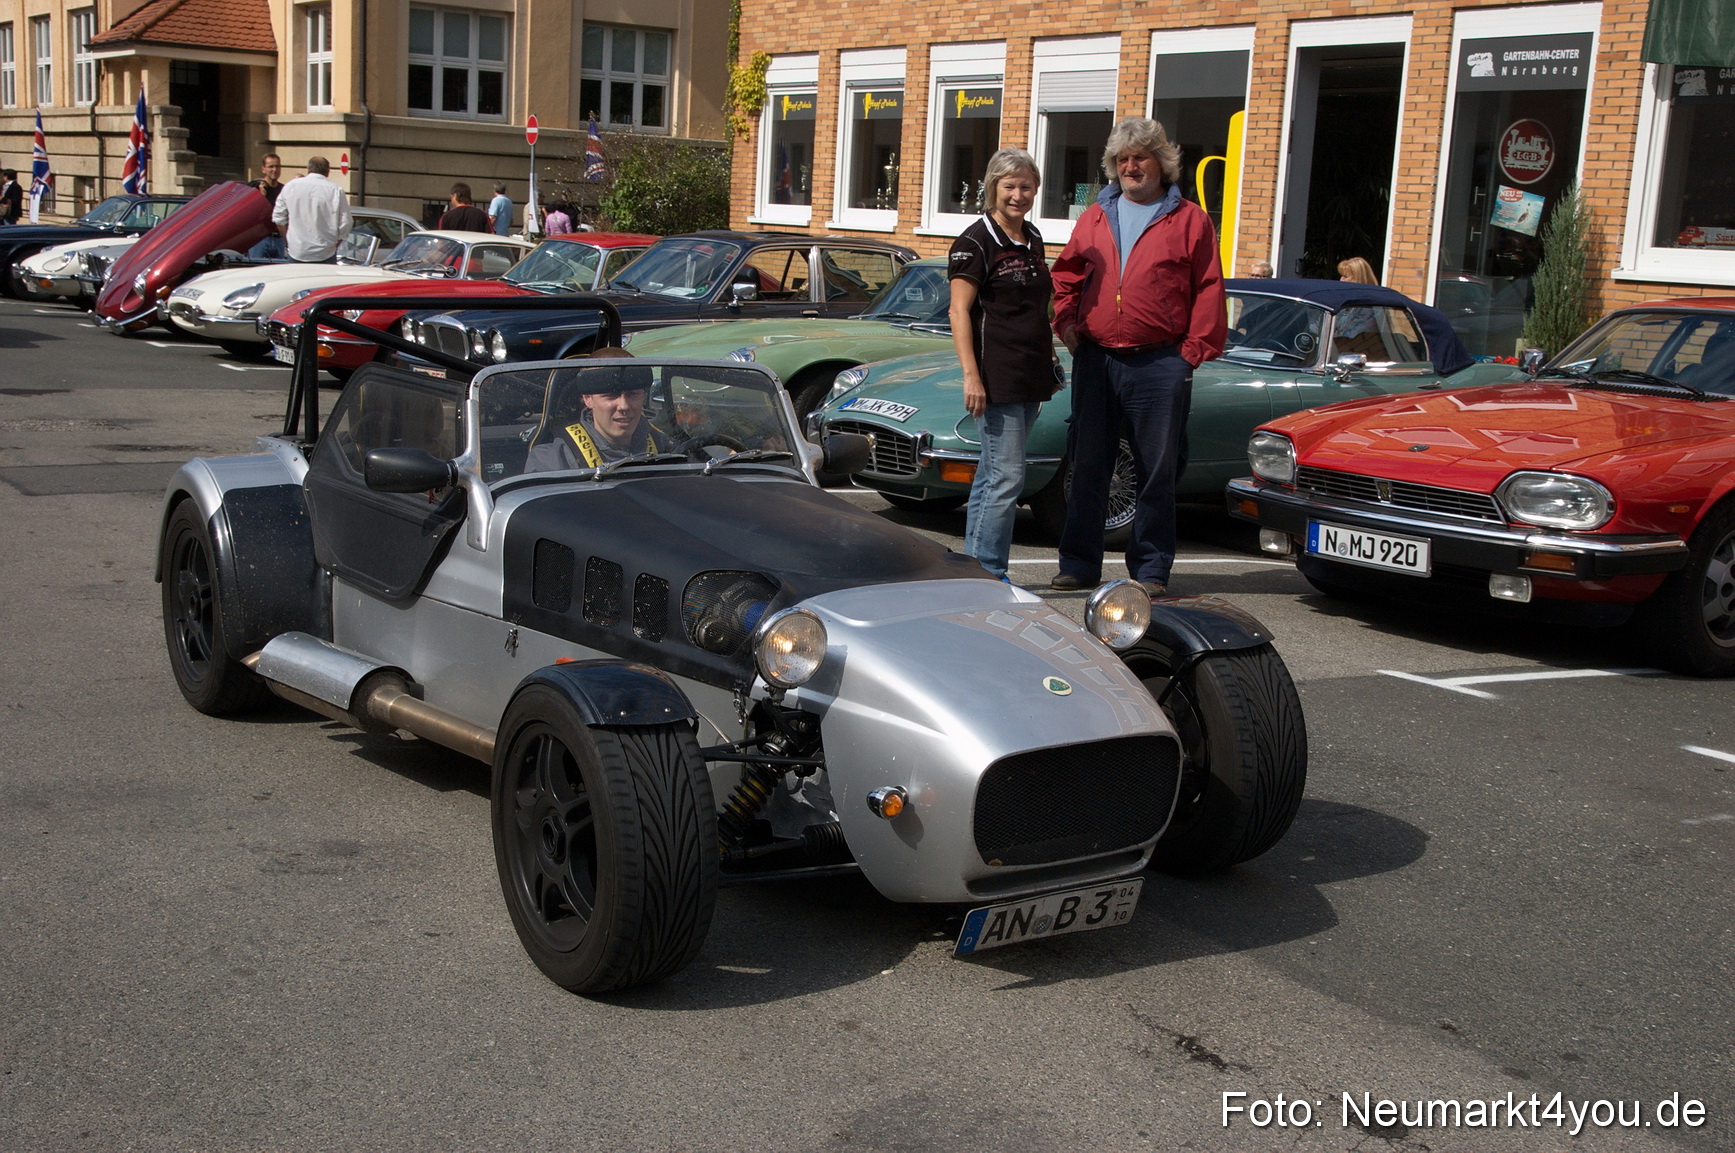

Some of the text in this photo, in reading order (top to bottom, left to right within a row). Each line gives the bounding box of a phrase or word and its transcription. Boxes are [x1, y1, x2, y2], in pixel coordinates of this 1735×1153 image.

[1503, 49, 1580, 62] GARTENBAHN-CENTER
[1500, 190, 1515, 198] NEU
[1349, 533, 1376, 560] MJ
[1380, 539, 1418, 567] 920
[1120, 887, 1134, 899] 04
[980, 904, 1037, 945] AN
